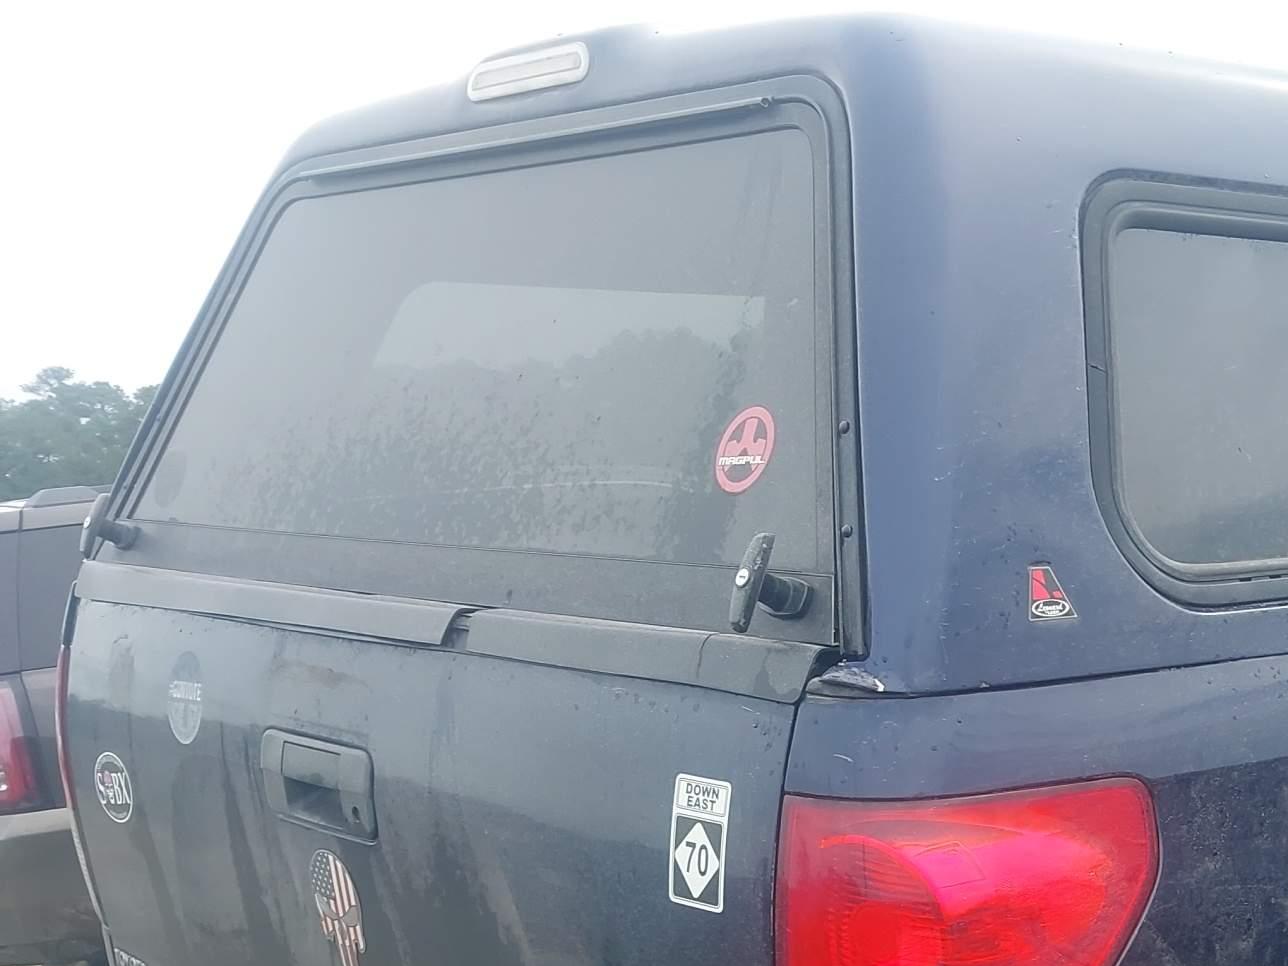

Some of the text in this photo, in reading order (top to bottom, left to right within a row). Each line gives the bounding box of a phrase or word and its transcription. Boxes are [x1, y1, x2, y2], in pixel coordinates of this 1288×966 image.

[718, 455, 766, 466] MAGPUL
[685, 783, 720, 799] DOWN
[686, 795, 717, 811] EAST
[685, 841, 709, 877] 70
